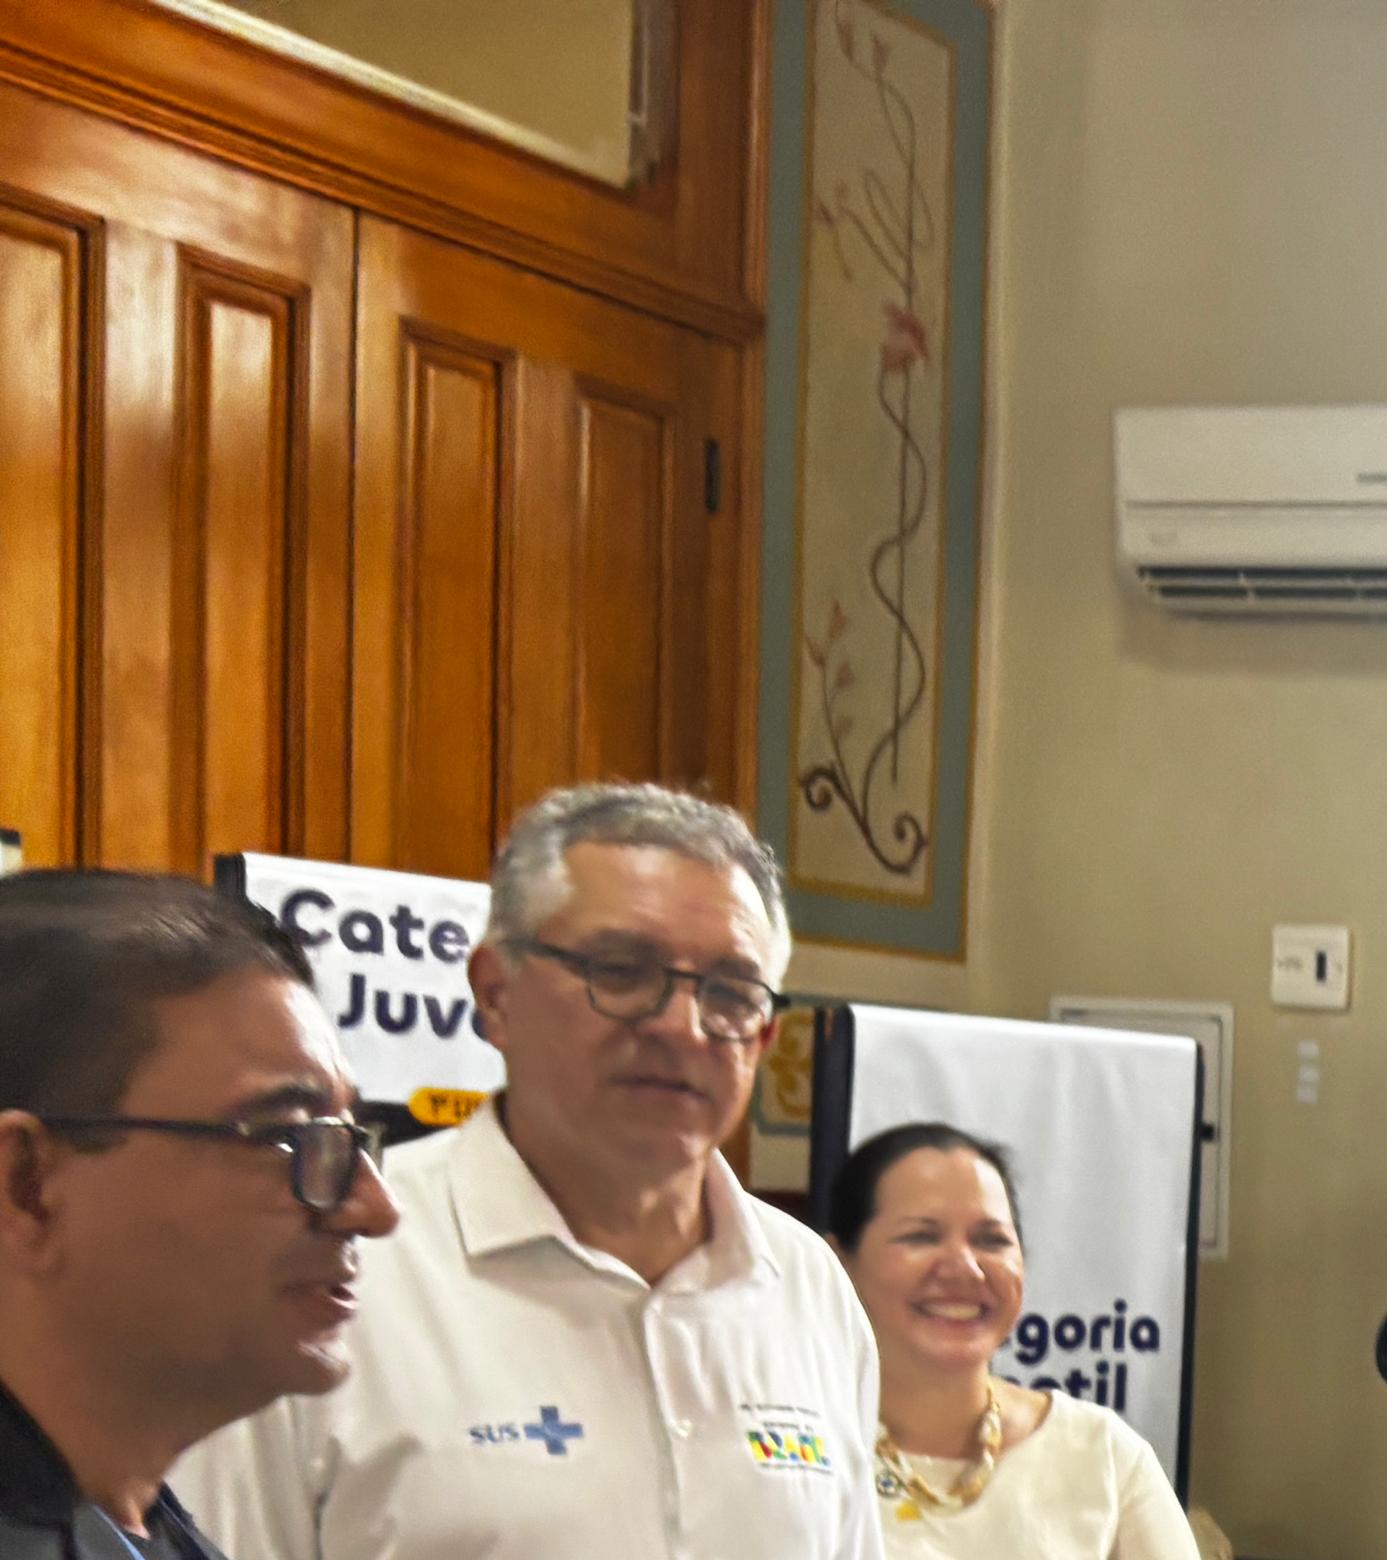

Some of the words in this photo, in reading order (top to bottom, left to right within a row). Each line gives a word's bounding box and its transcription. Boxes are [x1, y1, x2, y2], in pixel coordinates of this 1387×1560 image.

[337, 972, 487, 1040] Juv
[1001, 1298, 1160, 1366] goria
[469, 1423, 520, 1445] SUS
